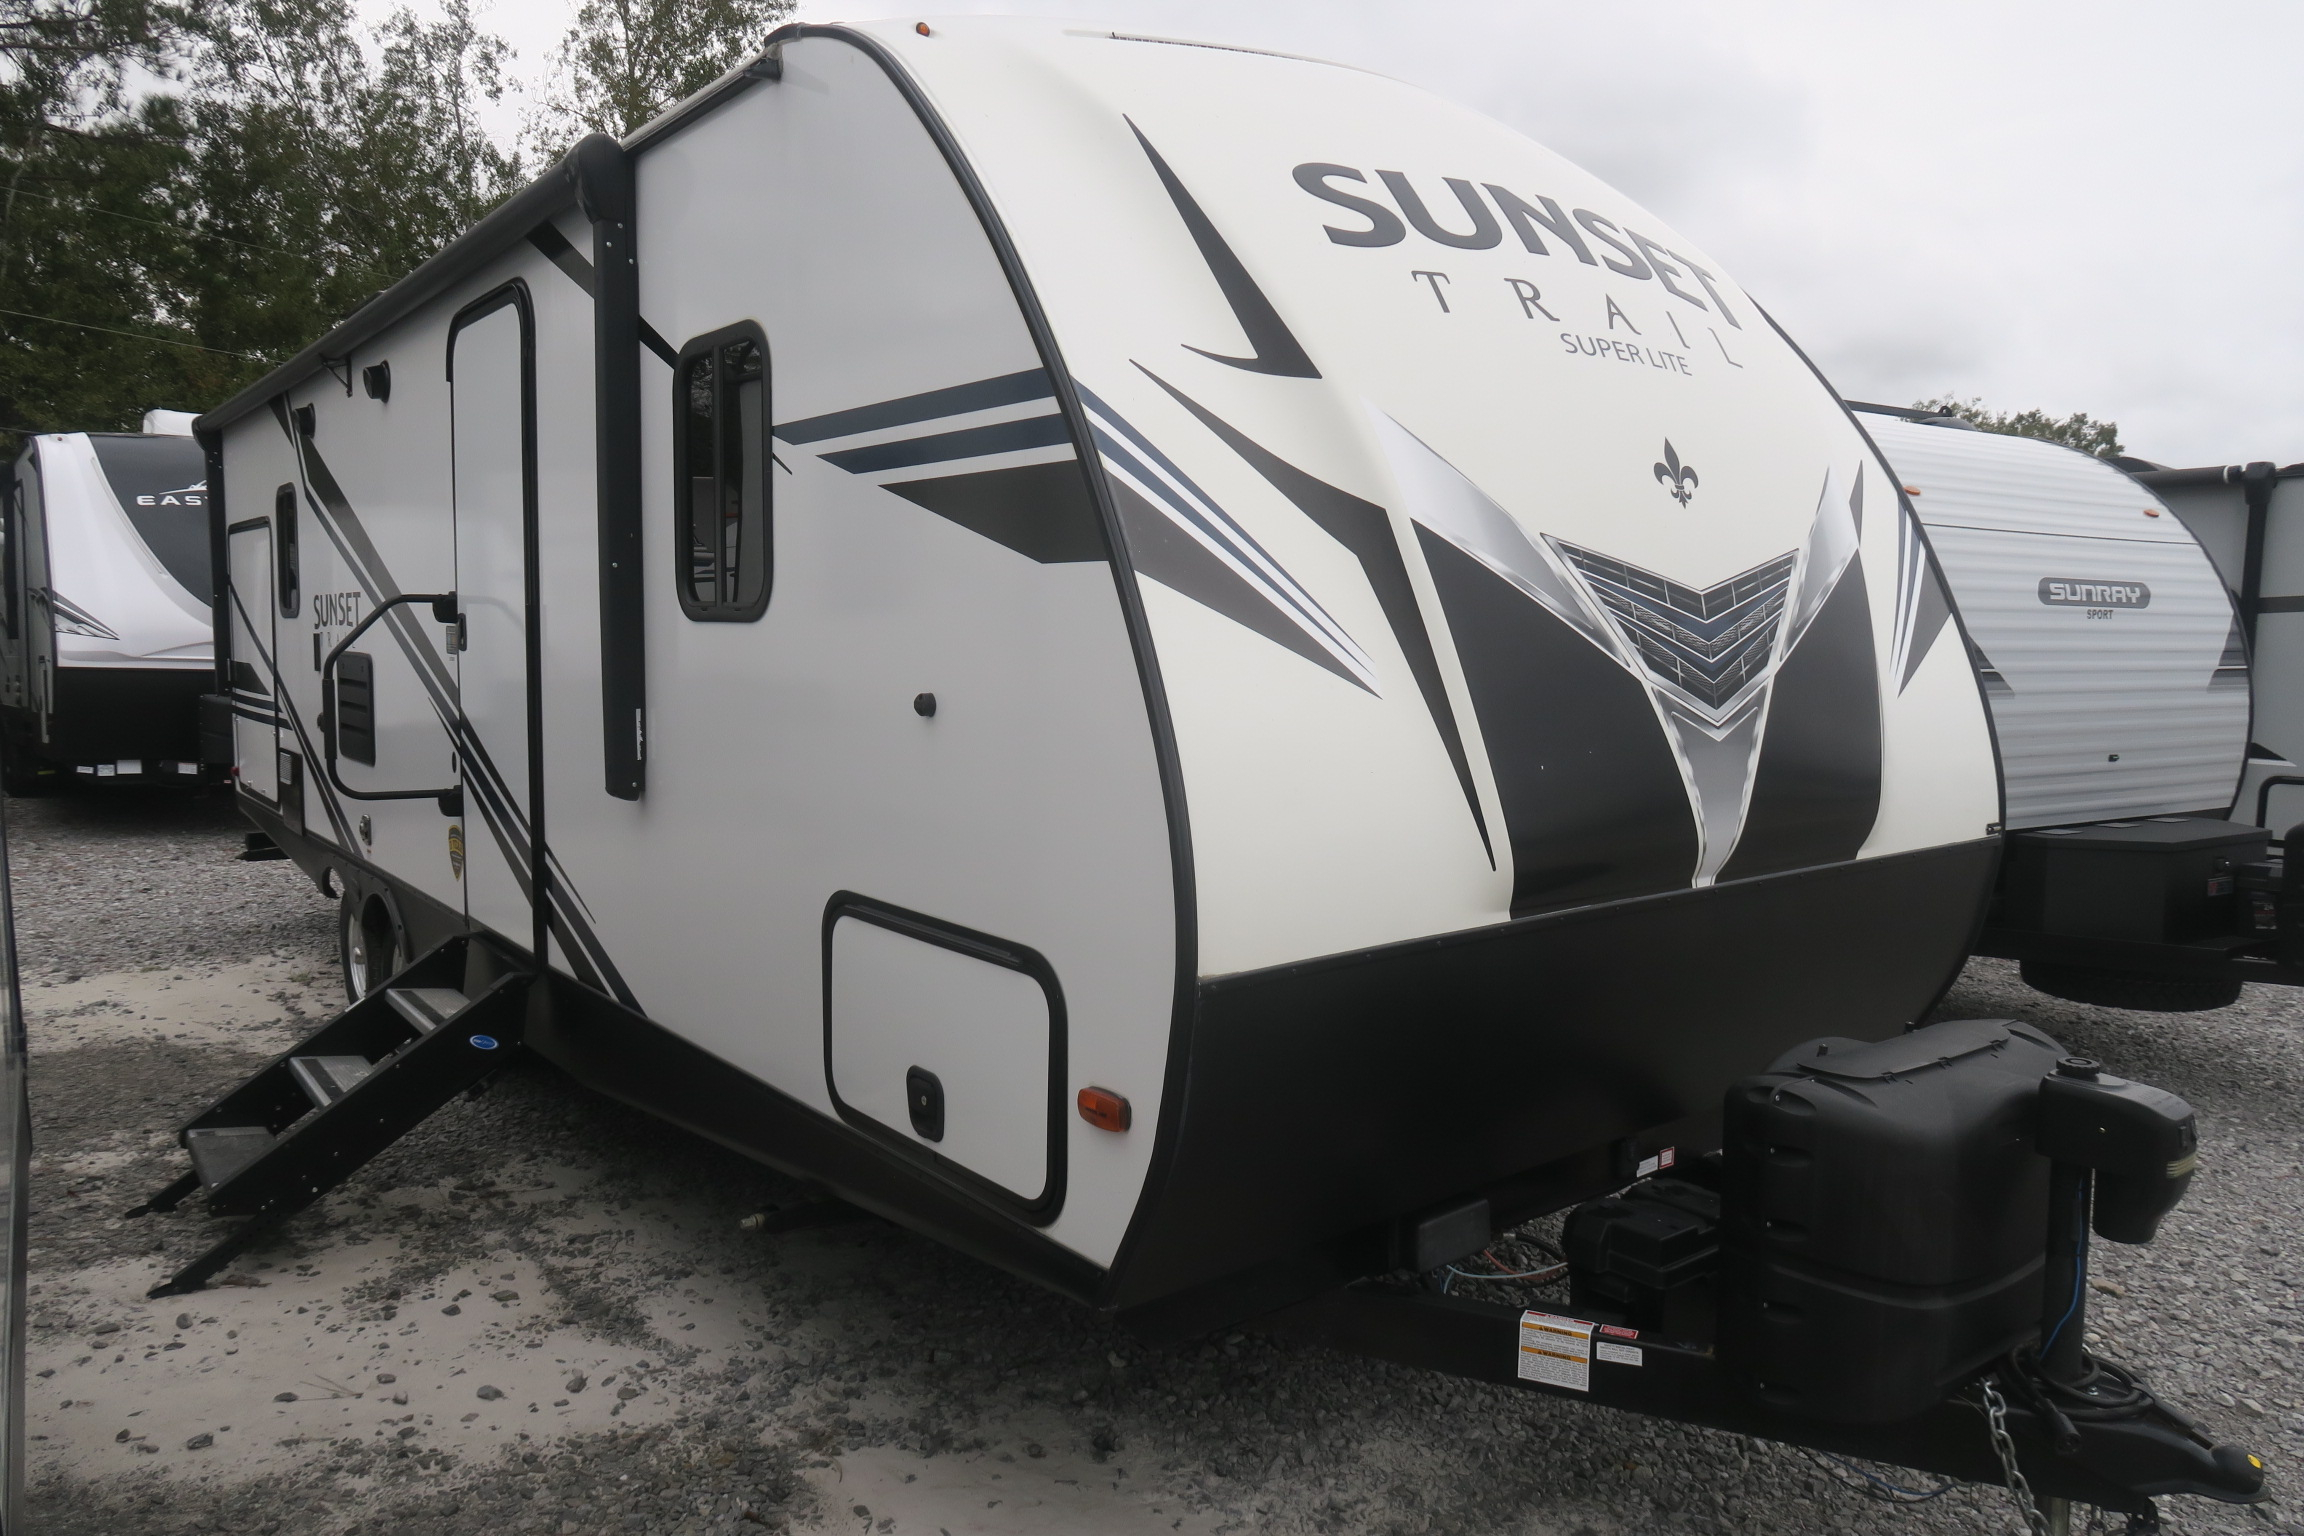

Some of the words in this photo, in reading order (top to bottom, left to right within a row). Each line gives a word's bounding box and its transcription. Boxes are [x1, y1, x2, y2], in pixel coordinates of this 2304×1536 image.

[1292, 162, 1742, 330] SUNSET
[1411, 270, 1743, 368] TRAIL
[1560, 333, 1645, 364] SUPER
[1646, 348, 1692, 376] LITE
[136, 495, 208, 506] EAS
[2049, 583, 2140, 603] SUNRAY
[313, 591, 361, 628] SUNSET
[2087, 609, 2113, 619] SPORT
[1543, 1327, 1572, 1336] WARNING
[1542, 1350, 1571, 1360] WARNING
